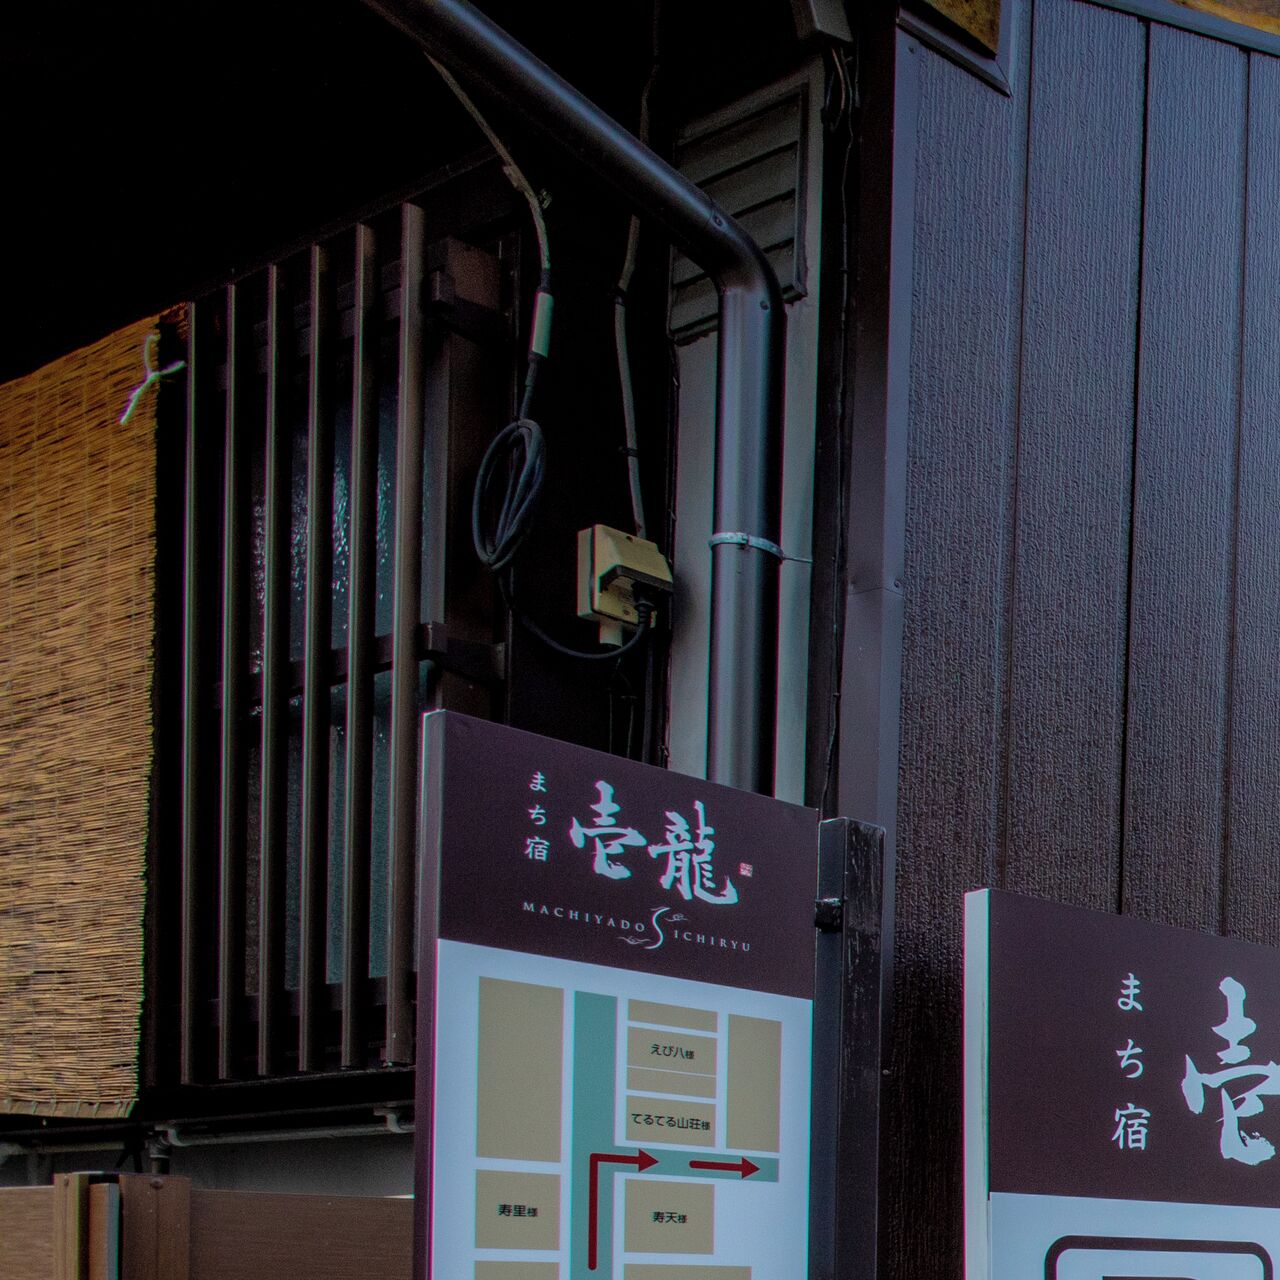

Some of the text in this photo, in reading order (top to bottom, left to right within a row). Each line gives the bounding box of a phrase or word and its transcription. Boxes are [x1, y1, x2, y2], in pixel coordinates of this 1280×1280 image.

[523, 771, 549, 862] まち宿
[523, 902, 751, 952] MACHIYADO ICHIRYU
[1110, 973, 1152, 1152] まち宿
